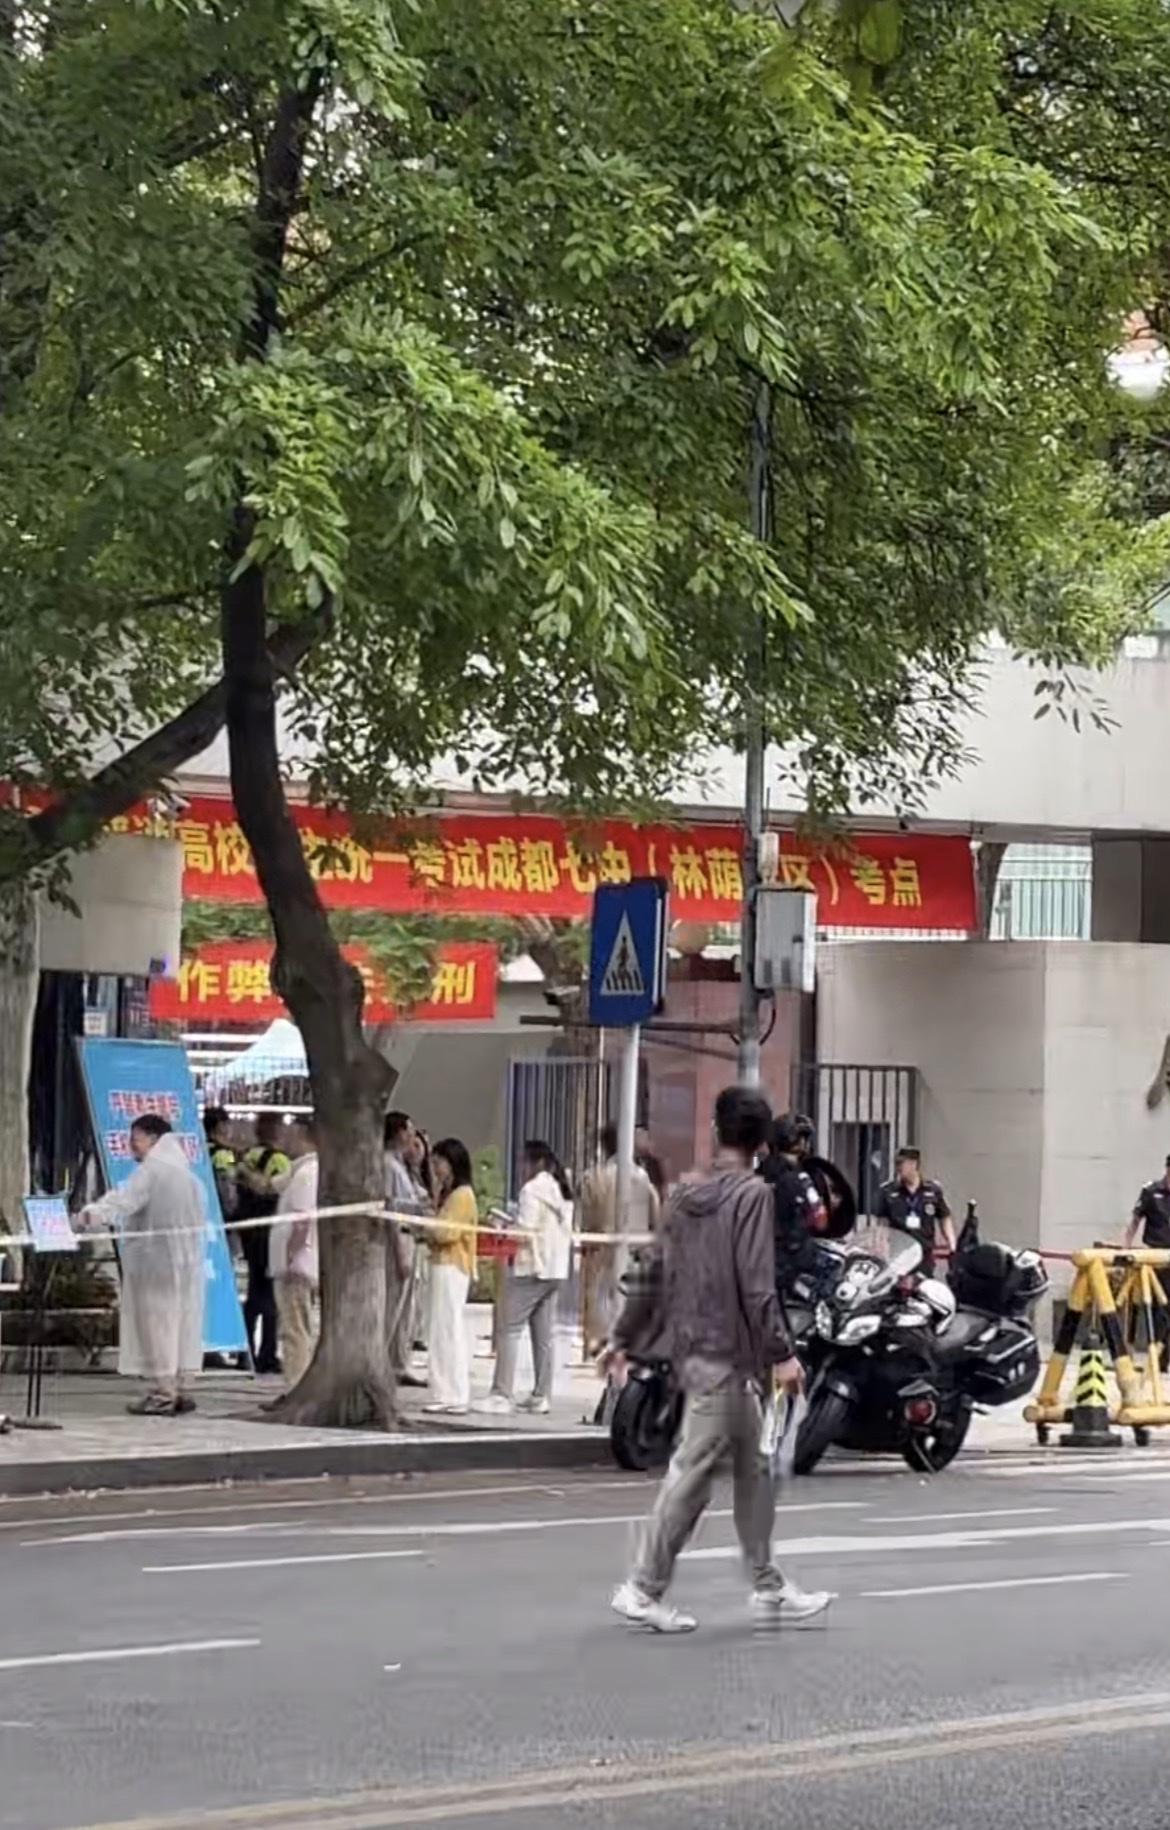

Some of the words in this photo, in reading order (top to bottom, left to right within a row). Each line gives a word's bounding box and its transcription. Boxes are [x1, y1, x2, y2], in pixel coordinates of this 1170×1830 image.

[102, 816, 922, 906] 高校统一考试成都七中（林荫区）考点
[176, 958, 476, 1005] 作弊刑
